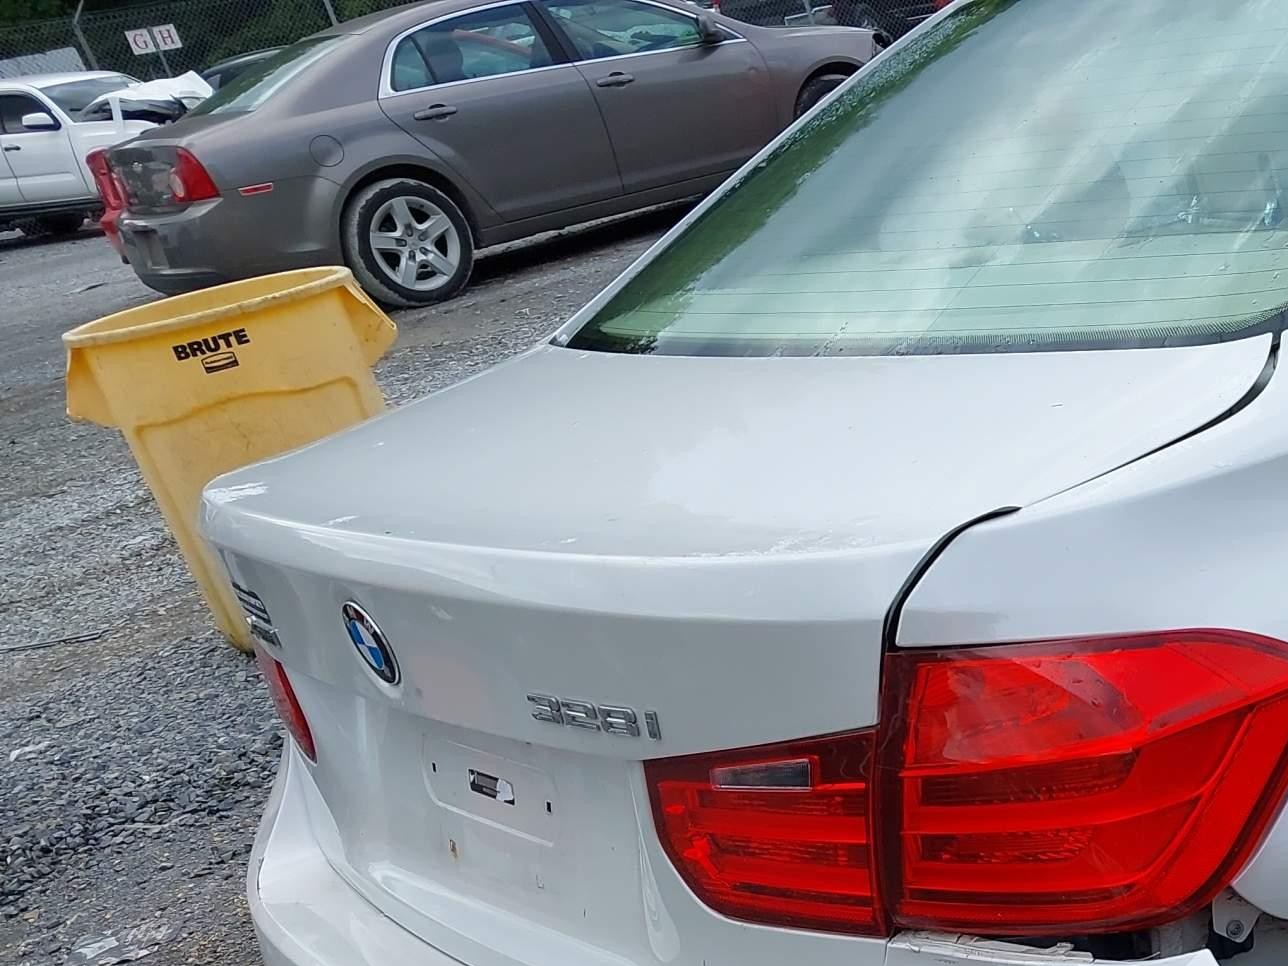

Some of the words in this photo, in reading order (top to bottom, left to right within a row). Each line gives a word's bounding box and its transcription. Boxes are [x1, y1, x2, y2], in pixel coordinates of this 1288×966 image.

[133, 33, 149, 50] G
[157, 29, 175, 46] H
[172, 328, 251, 361] BRUTE
[527, 692, 662, 740] 328i
